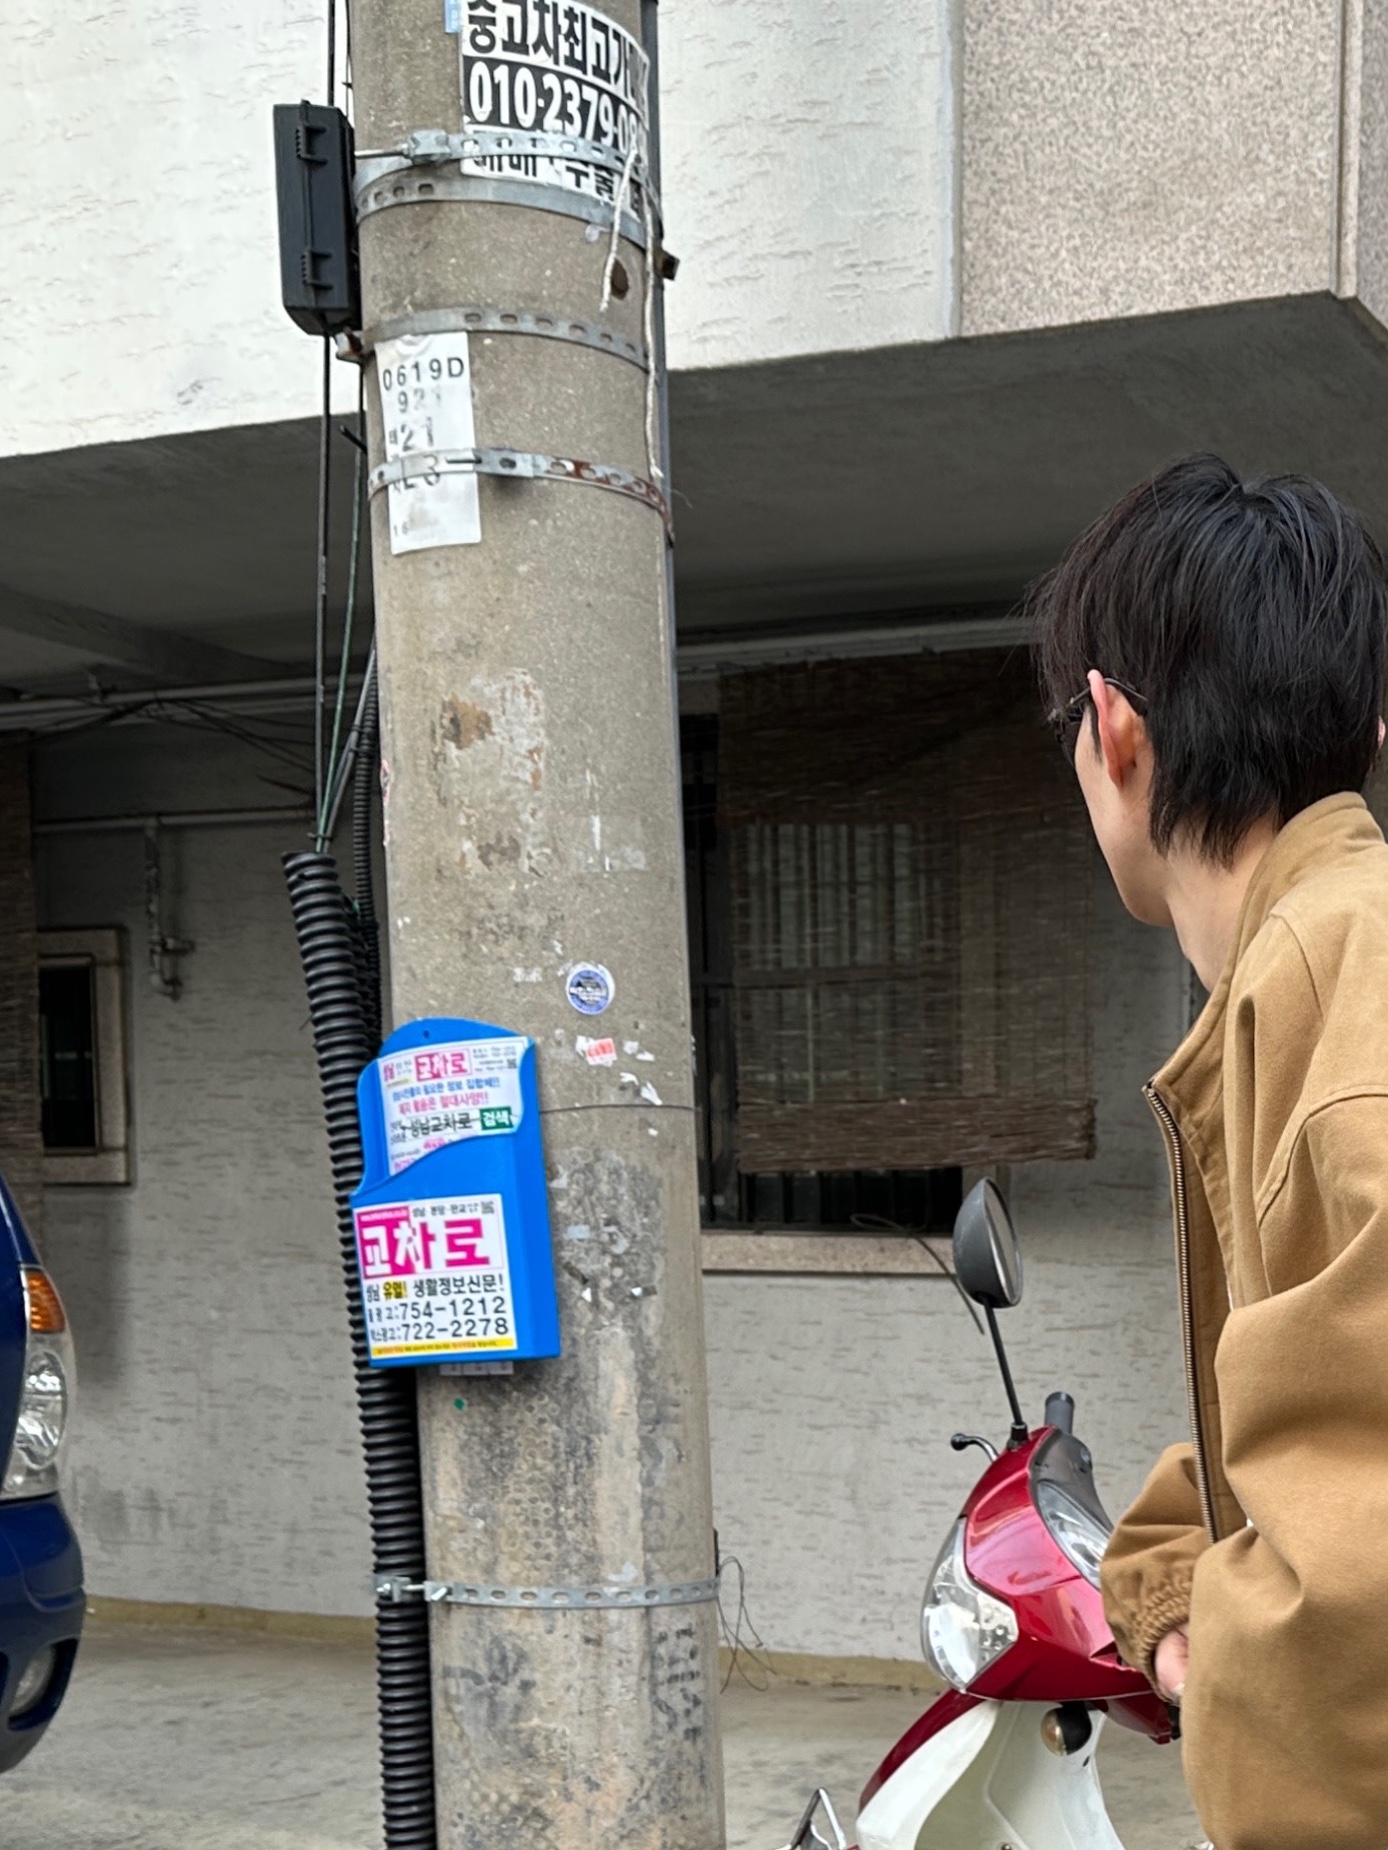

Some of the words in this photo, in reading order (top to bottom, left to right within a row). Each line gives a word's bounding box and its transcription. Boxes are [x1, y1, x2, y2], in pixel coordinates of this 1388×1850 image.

[382, 356, 465, 392] 0619D
[415, 1052, 468, 1081] 교차로
[410, 1112, 474, 1138] 성남교차로
[482, 1110, 510, 1127] 검색
[361, 1217, 491, 1276] 교차로
[413, 1273, 505, 1299] 생활정보신문!
[400, 1295, 507, 1321] 754-1212
[401, 1316, 509, 1341] 722-2278
